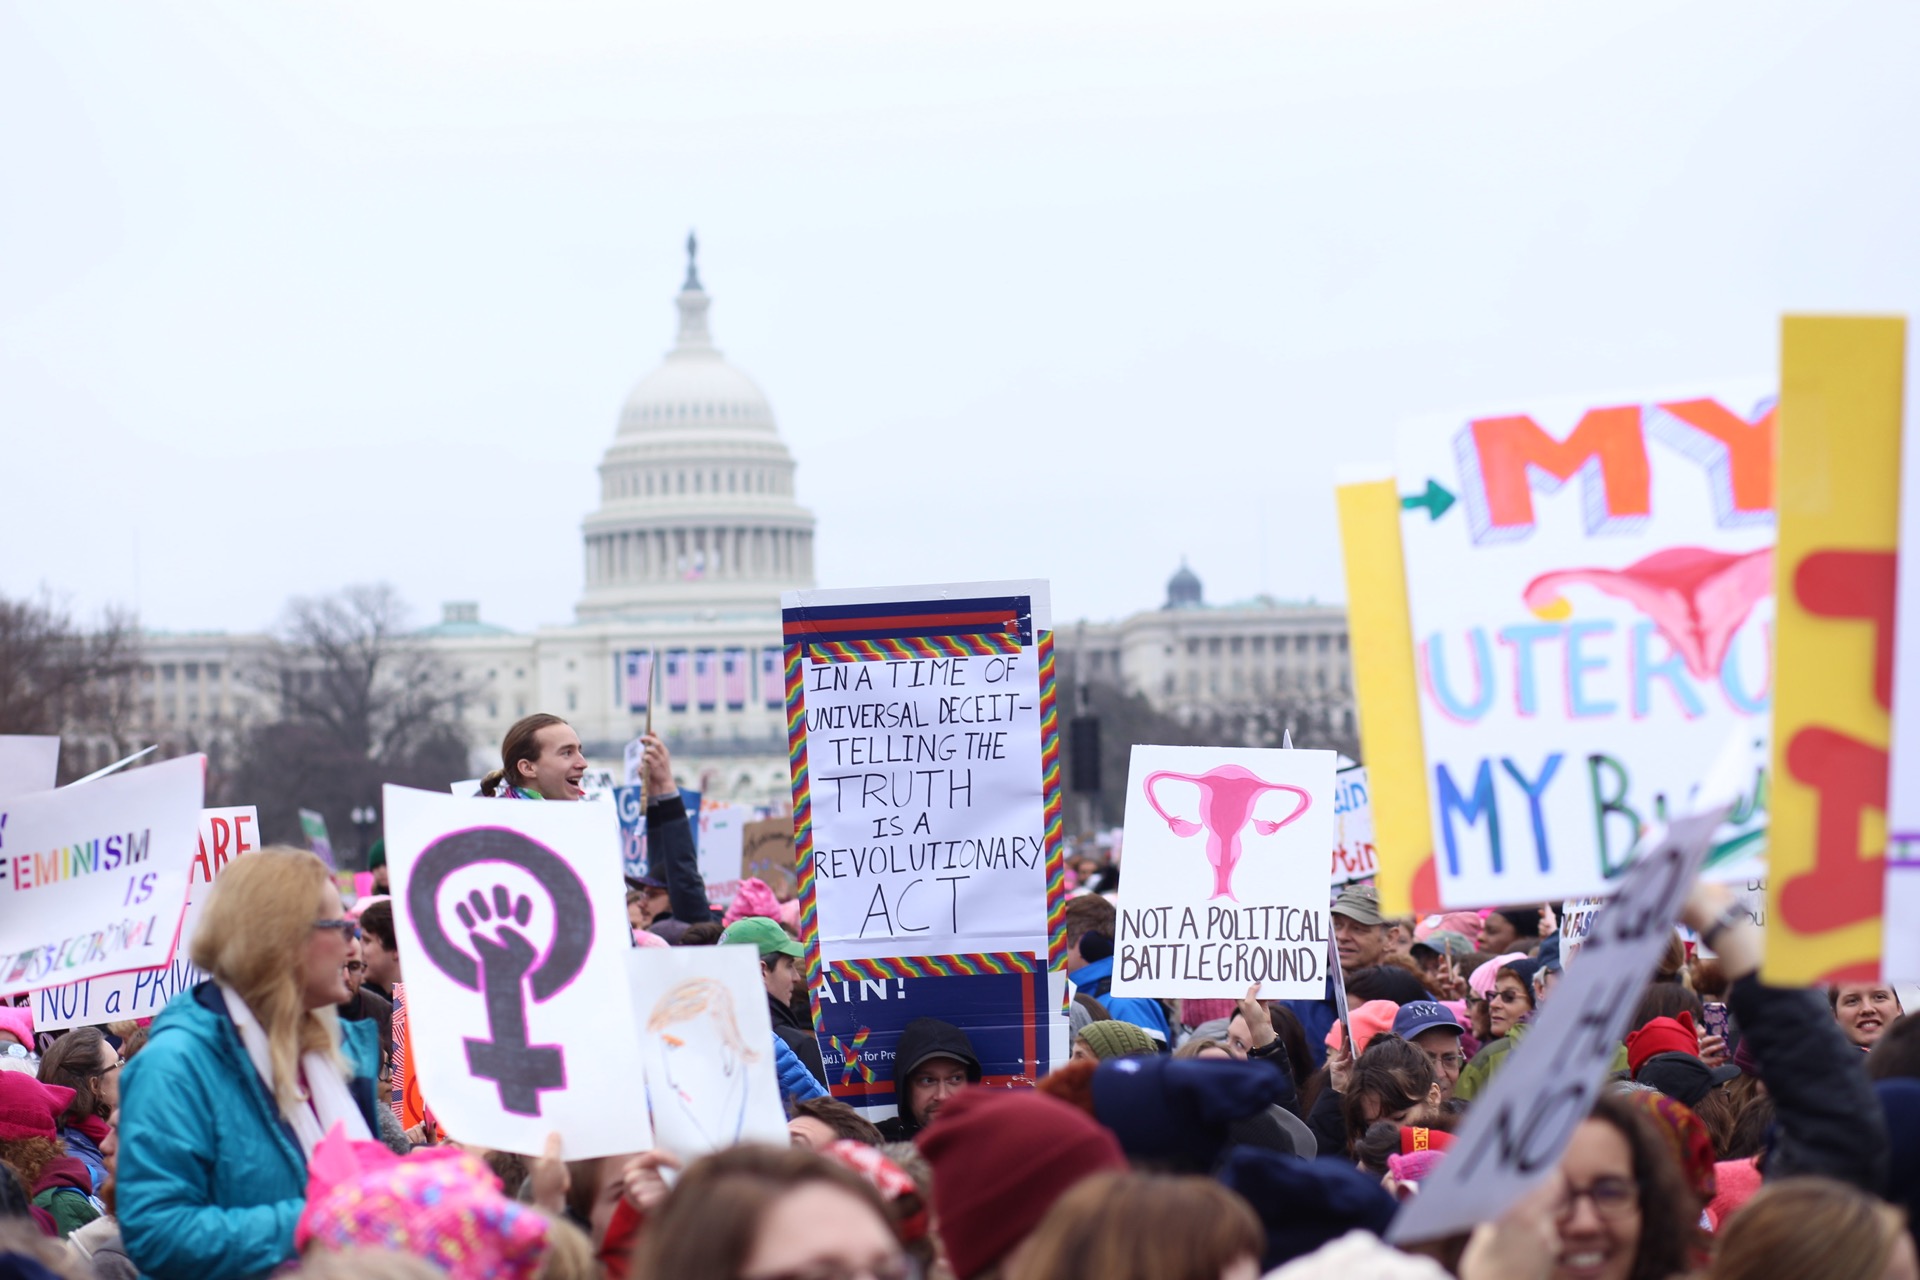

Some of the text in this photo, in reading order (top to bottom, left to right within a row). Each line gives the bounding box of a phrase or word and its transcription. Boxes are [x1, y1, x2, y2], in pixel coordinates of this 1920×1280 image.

[1452, 394, 1776, 545] MY
[810, 656, 1019, 692] IN A TIME OF
[1421, 620, 1768, 726] UTER
[805, 692, 1033, 733] UNIVERSAL DECEIT-
[828, 731, 1008, 766] TELLING THE
[817, 768, 972, 813] TRUTH
[872, 811, 931, 839] IS A
[1436, 754, 1563, 877] MY
[814, 835, 1046, 881] REVOLUTIONARY
[123, 872, 157, 907] IS
[858, 875, 971, 939] ACT
[1121, 905, 1328, 942] NOT A POLITICAL
[1120, 943, 1324, 982] BATTLEGROUND.
[105, 989, 121, 1014] a
[864, 1050, 879, 1062] for
